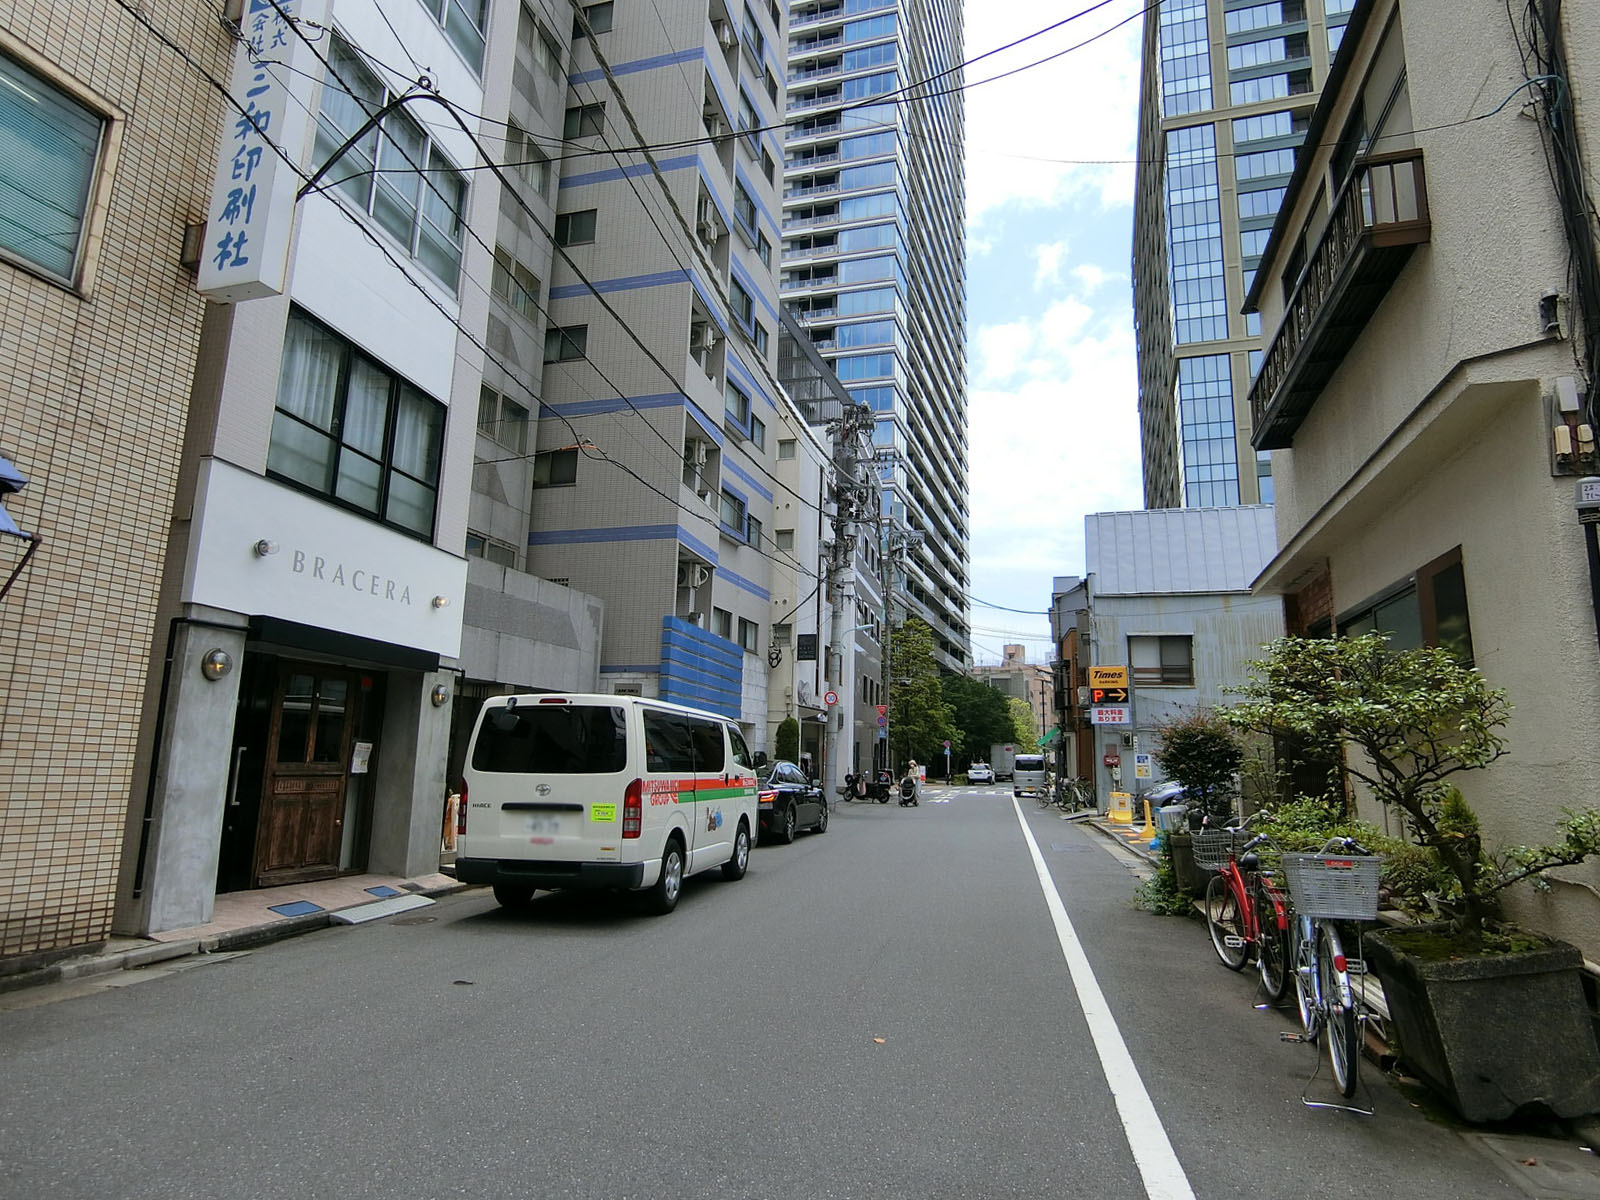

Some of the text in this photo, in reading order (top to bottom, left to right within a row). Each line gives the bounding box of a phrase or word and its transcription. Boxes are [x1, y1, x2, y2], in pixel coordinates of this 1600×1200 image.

[213, 60, 271, 271] 三和印刷社
[292, 551, 411, 605] BRACERA
[1093, 670, 1123, 679] Times
[1093, 689, 1104, 703] P
